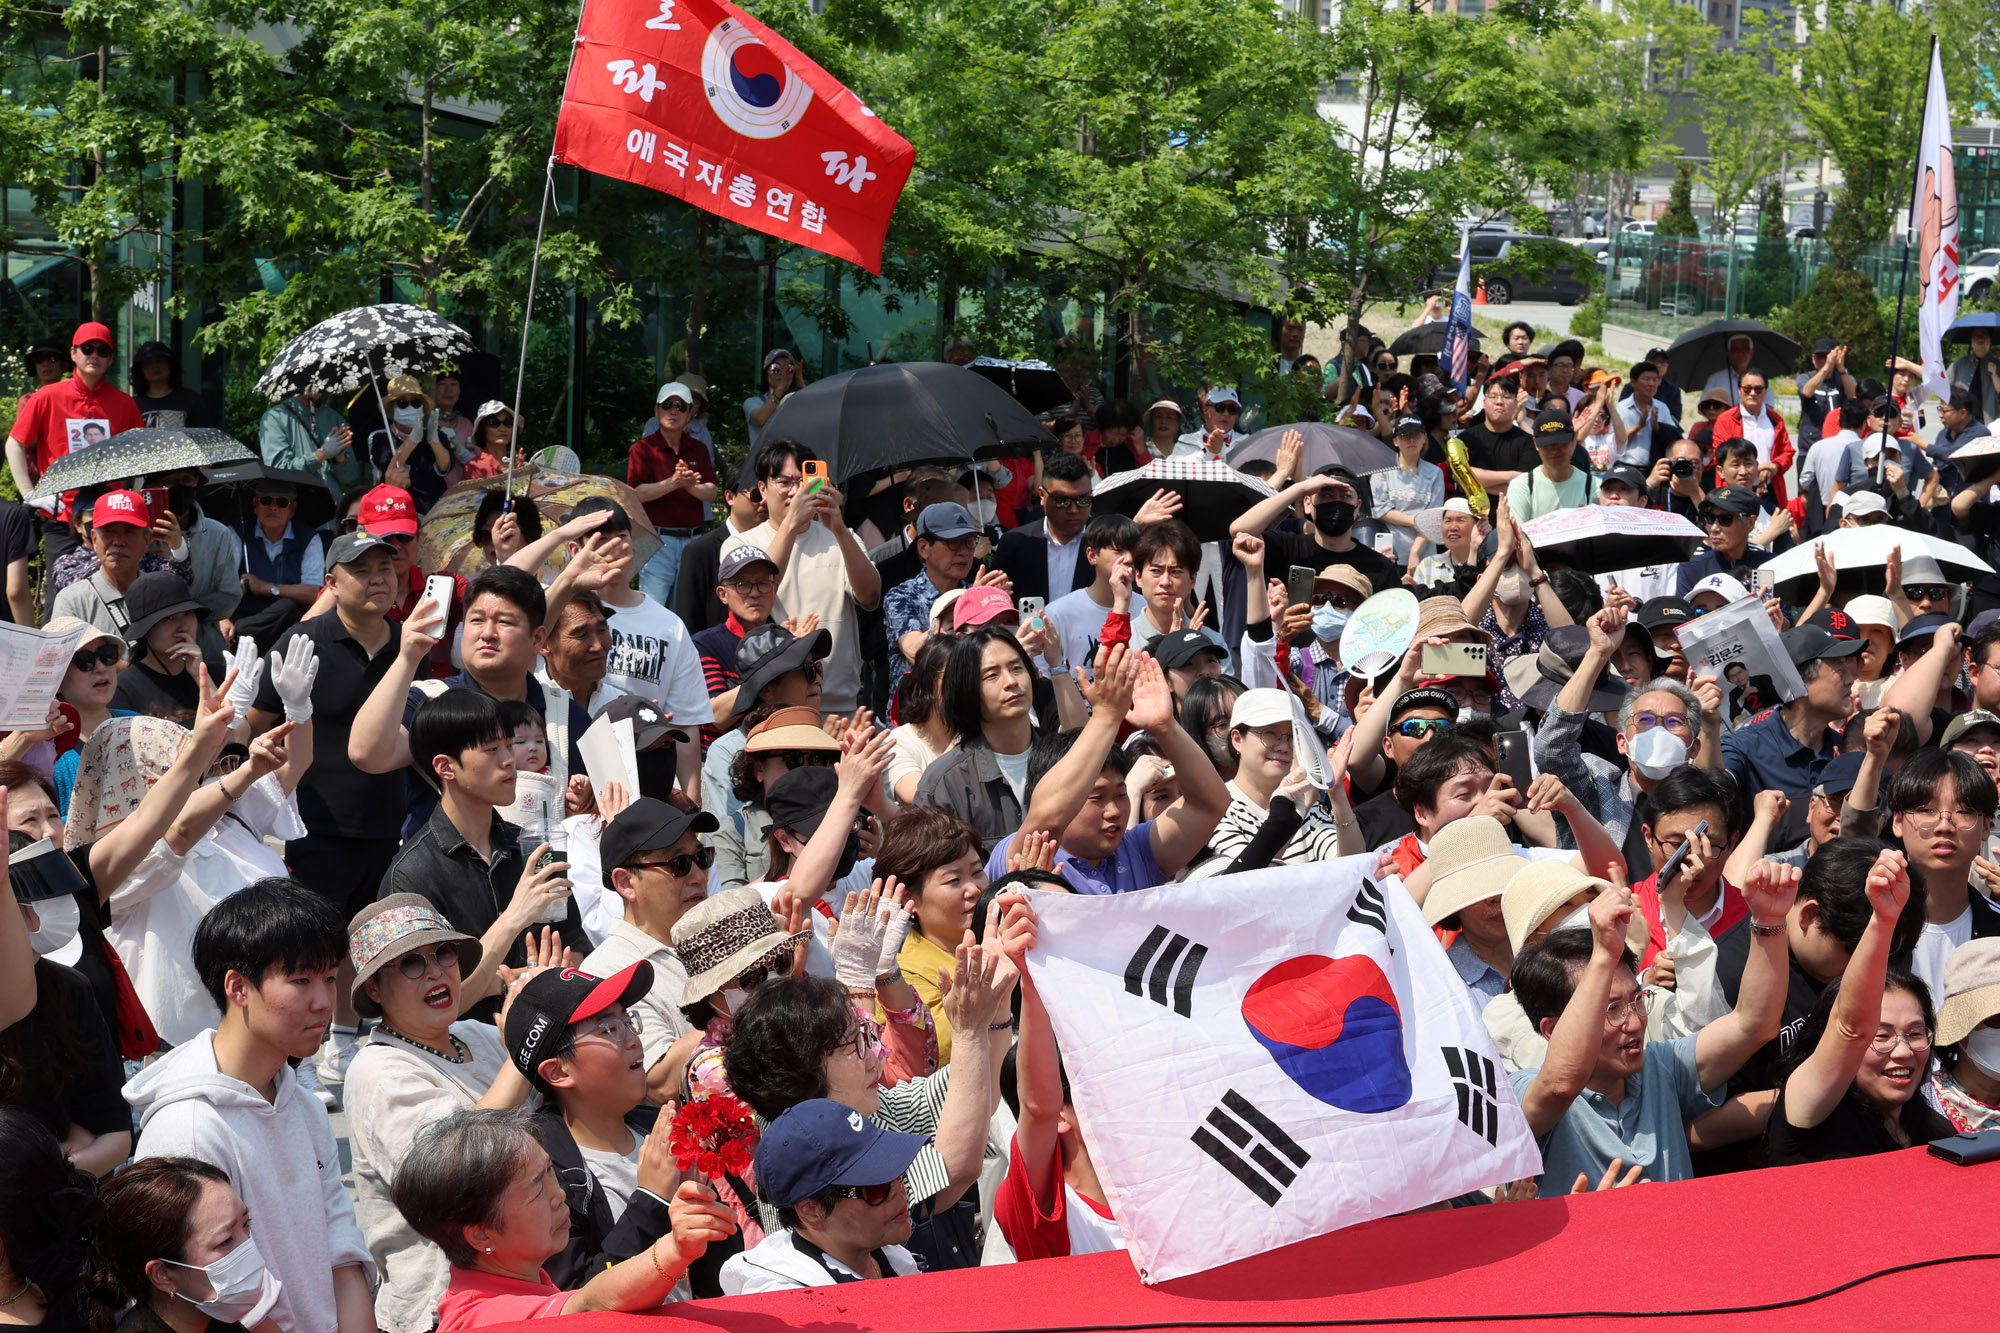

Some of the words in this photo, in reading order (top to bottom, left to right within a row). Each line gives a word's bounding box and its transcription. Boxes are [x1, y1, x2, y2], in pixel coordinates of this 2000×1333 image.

[626, 128, 827, 235] 애국자총연합
[71, 429, 81, 442] 2
[1708, 644, 1744, 667] 김문수
[1396, 696, 1410, 708] FIND
[1410, 690, 1430, 700] YOUR
[1430, 691, 1447, 700] OWN
[1446, 697, 1456, 709] WAY
[1747, 694, 1763, 710] 2
[519, 1017, 549, 1071] LGE.COM
